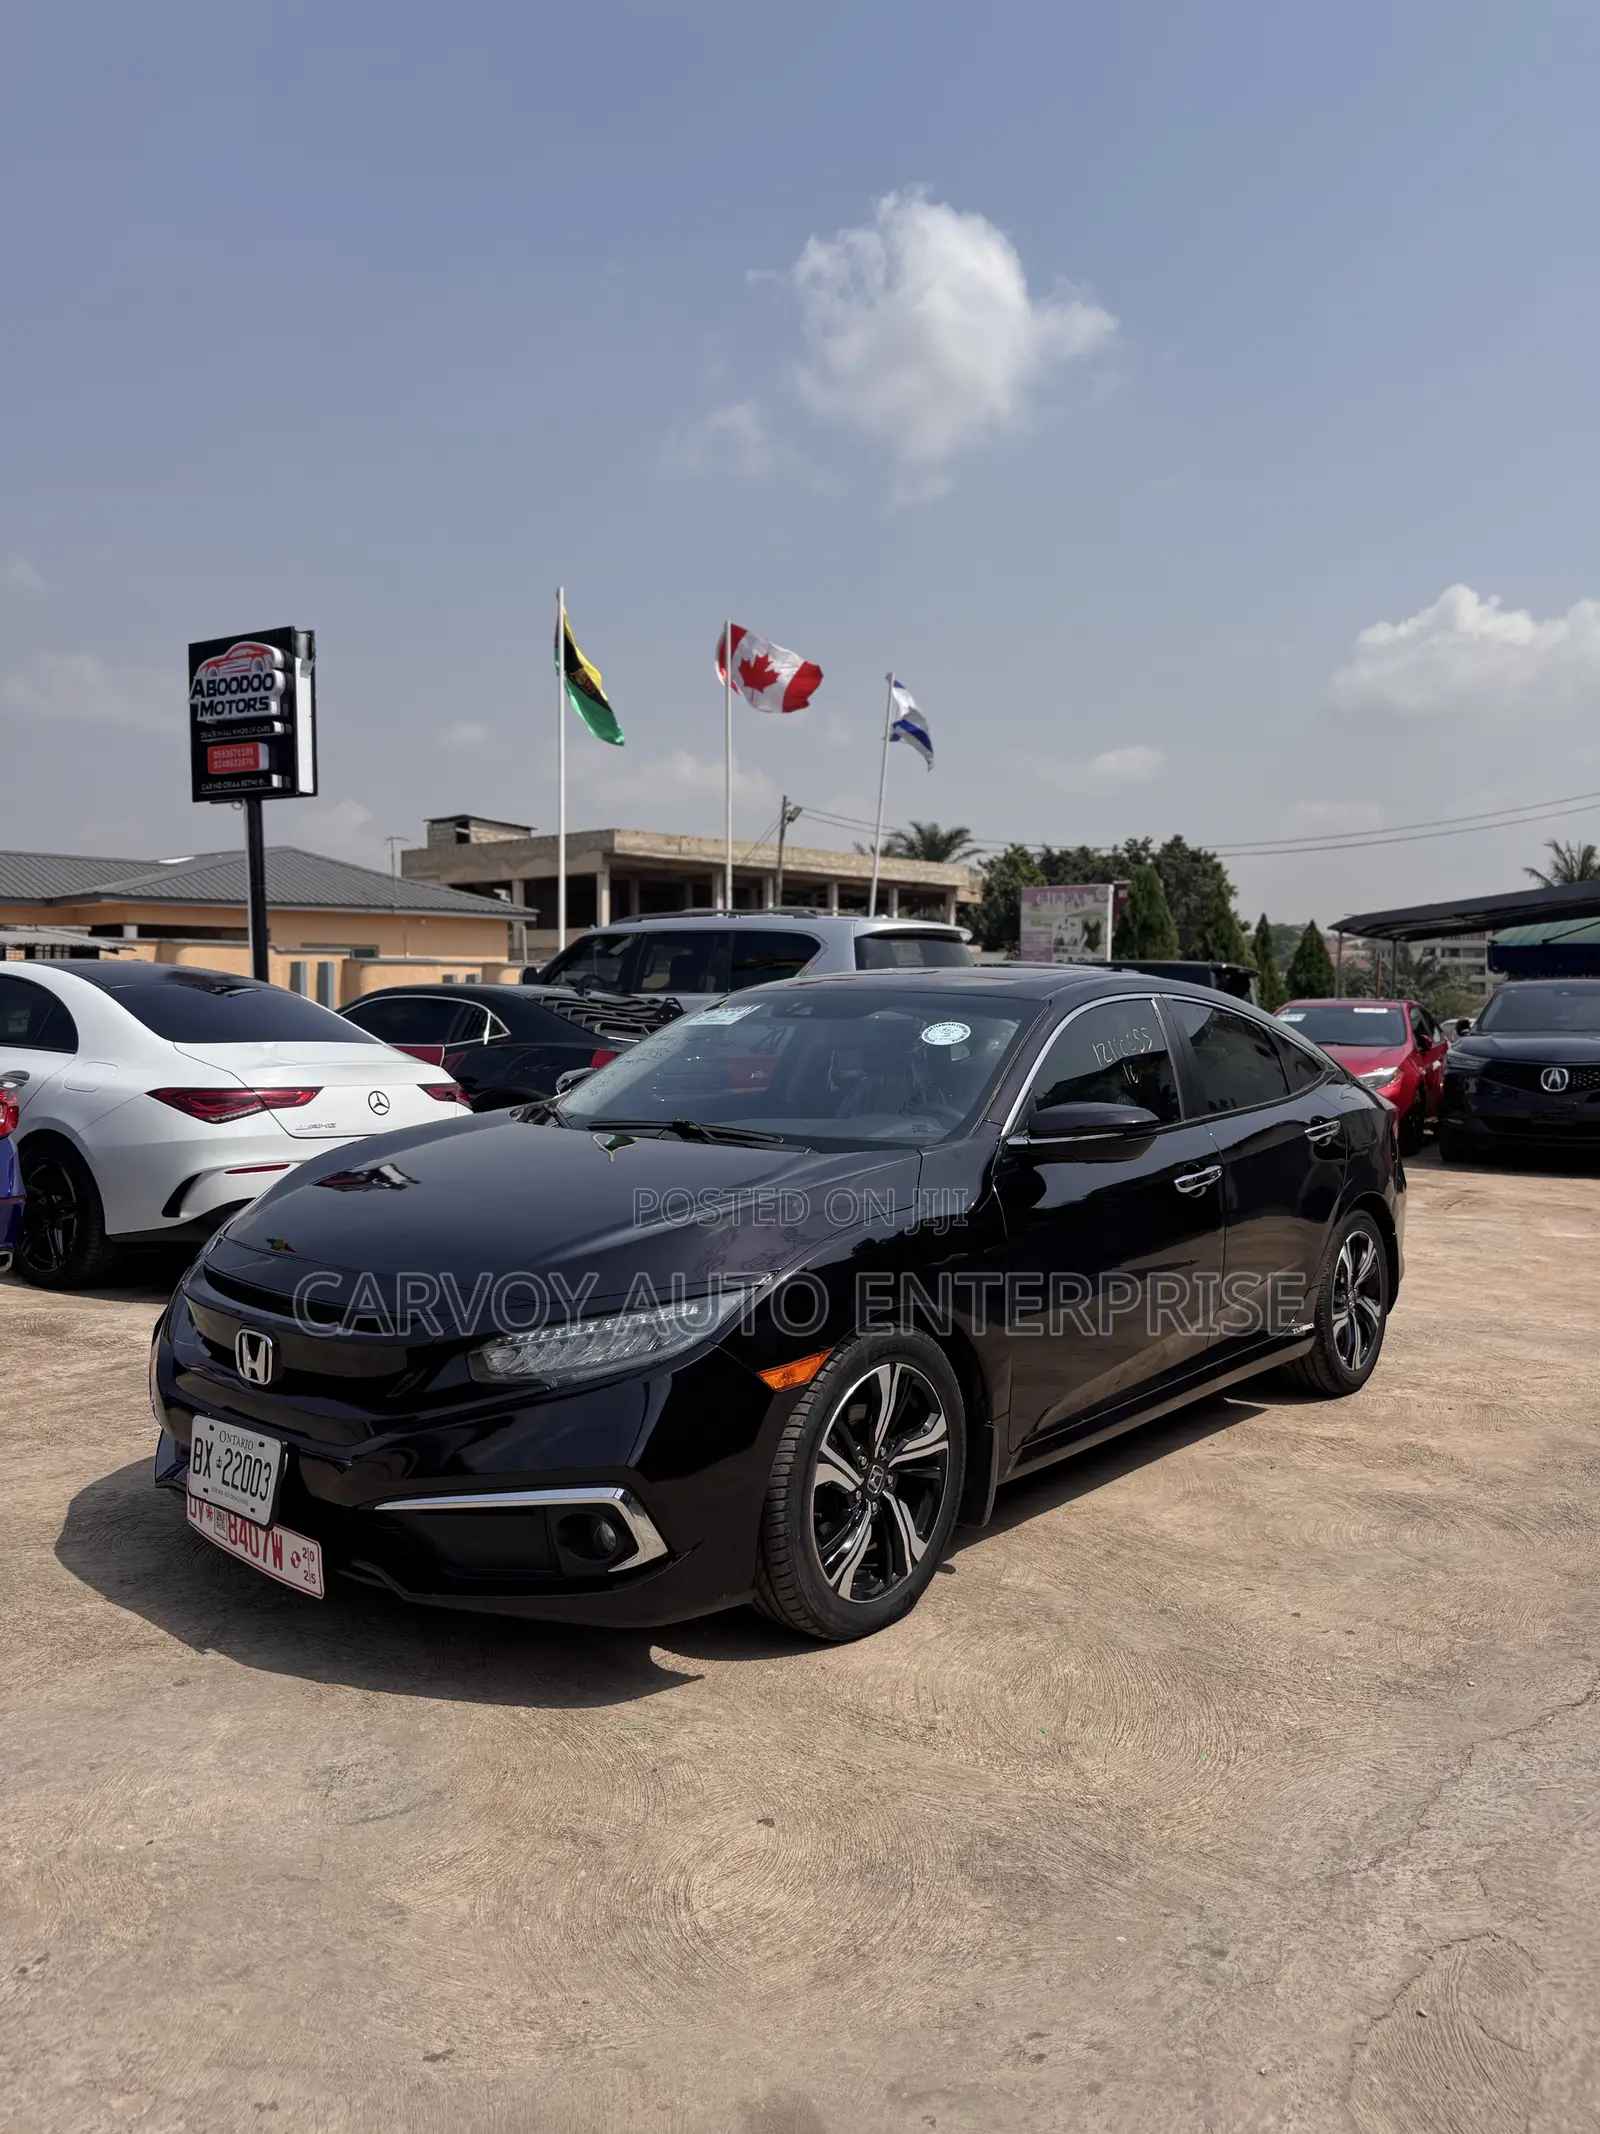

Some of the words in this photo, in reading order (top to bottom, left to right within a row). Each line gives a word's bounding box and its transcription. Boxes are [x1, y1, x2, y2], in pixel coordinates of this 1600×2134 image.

[191, 673, 275, 699] ABOODOO
[200, 696, 269, 717] MOTORS
[256, 725, 271, 733] CARS
[1291, 1322, 1315, 1334] TURBO
[219, 1430, 254, 1451] ONTARIO
[192, 1437, 214, 1479] BX
[221, 1448, 273, 1501] 22003
[303, 1569, 317, 1585] 25
